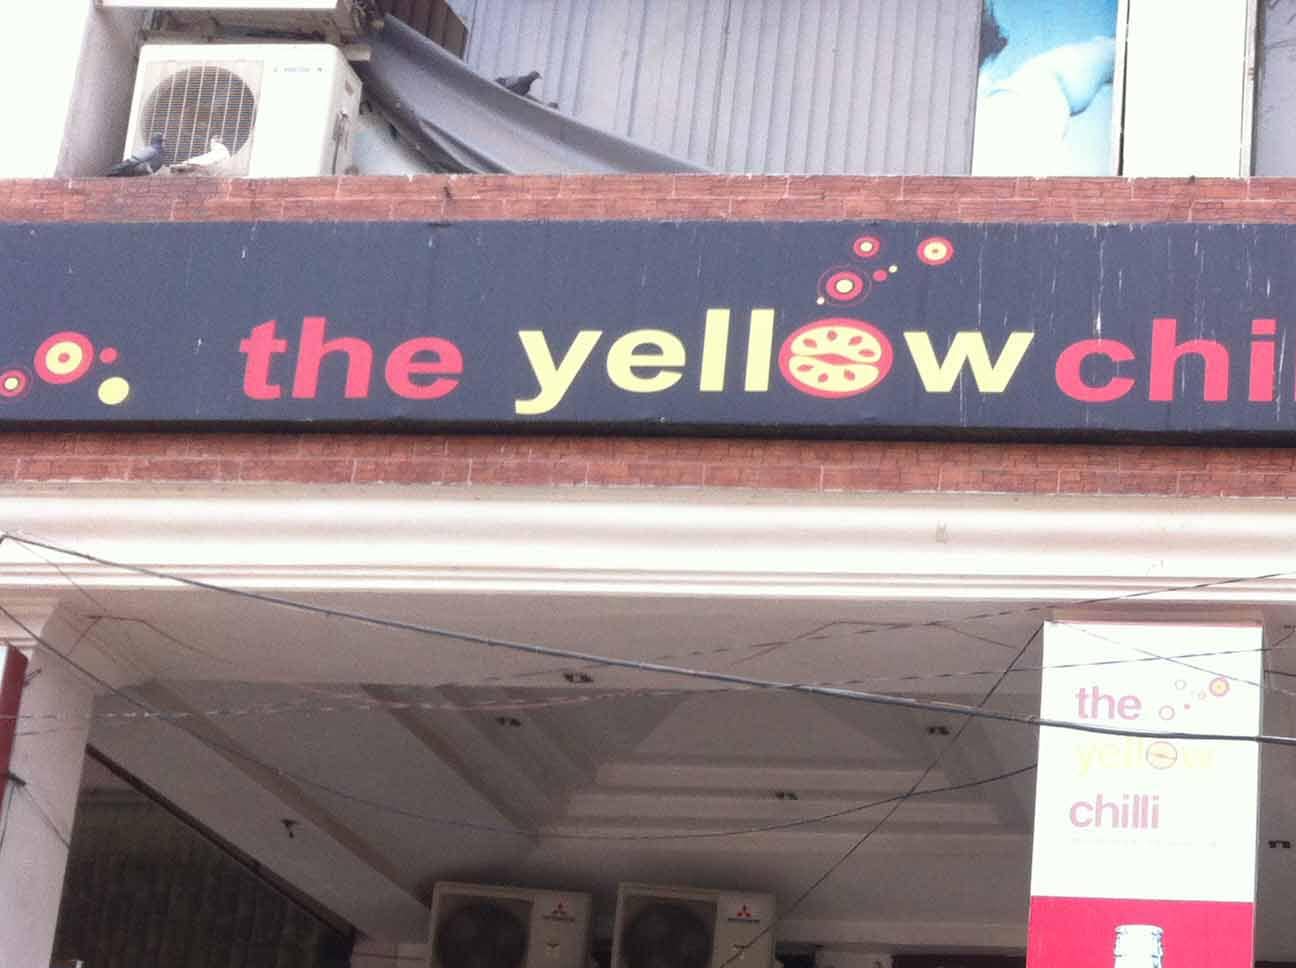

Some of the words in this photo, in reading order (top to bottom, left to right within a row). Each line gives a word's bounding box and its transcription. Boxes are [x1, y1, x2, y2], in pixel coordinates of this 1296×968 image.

[243, 317, 464, 400] the
[514, 308, 1034, 416] yellow
[1075, 686, 1142, 721] the
[1069, 793, 1160, 830] chilli
